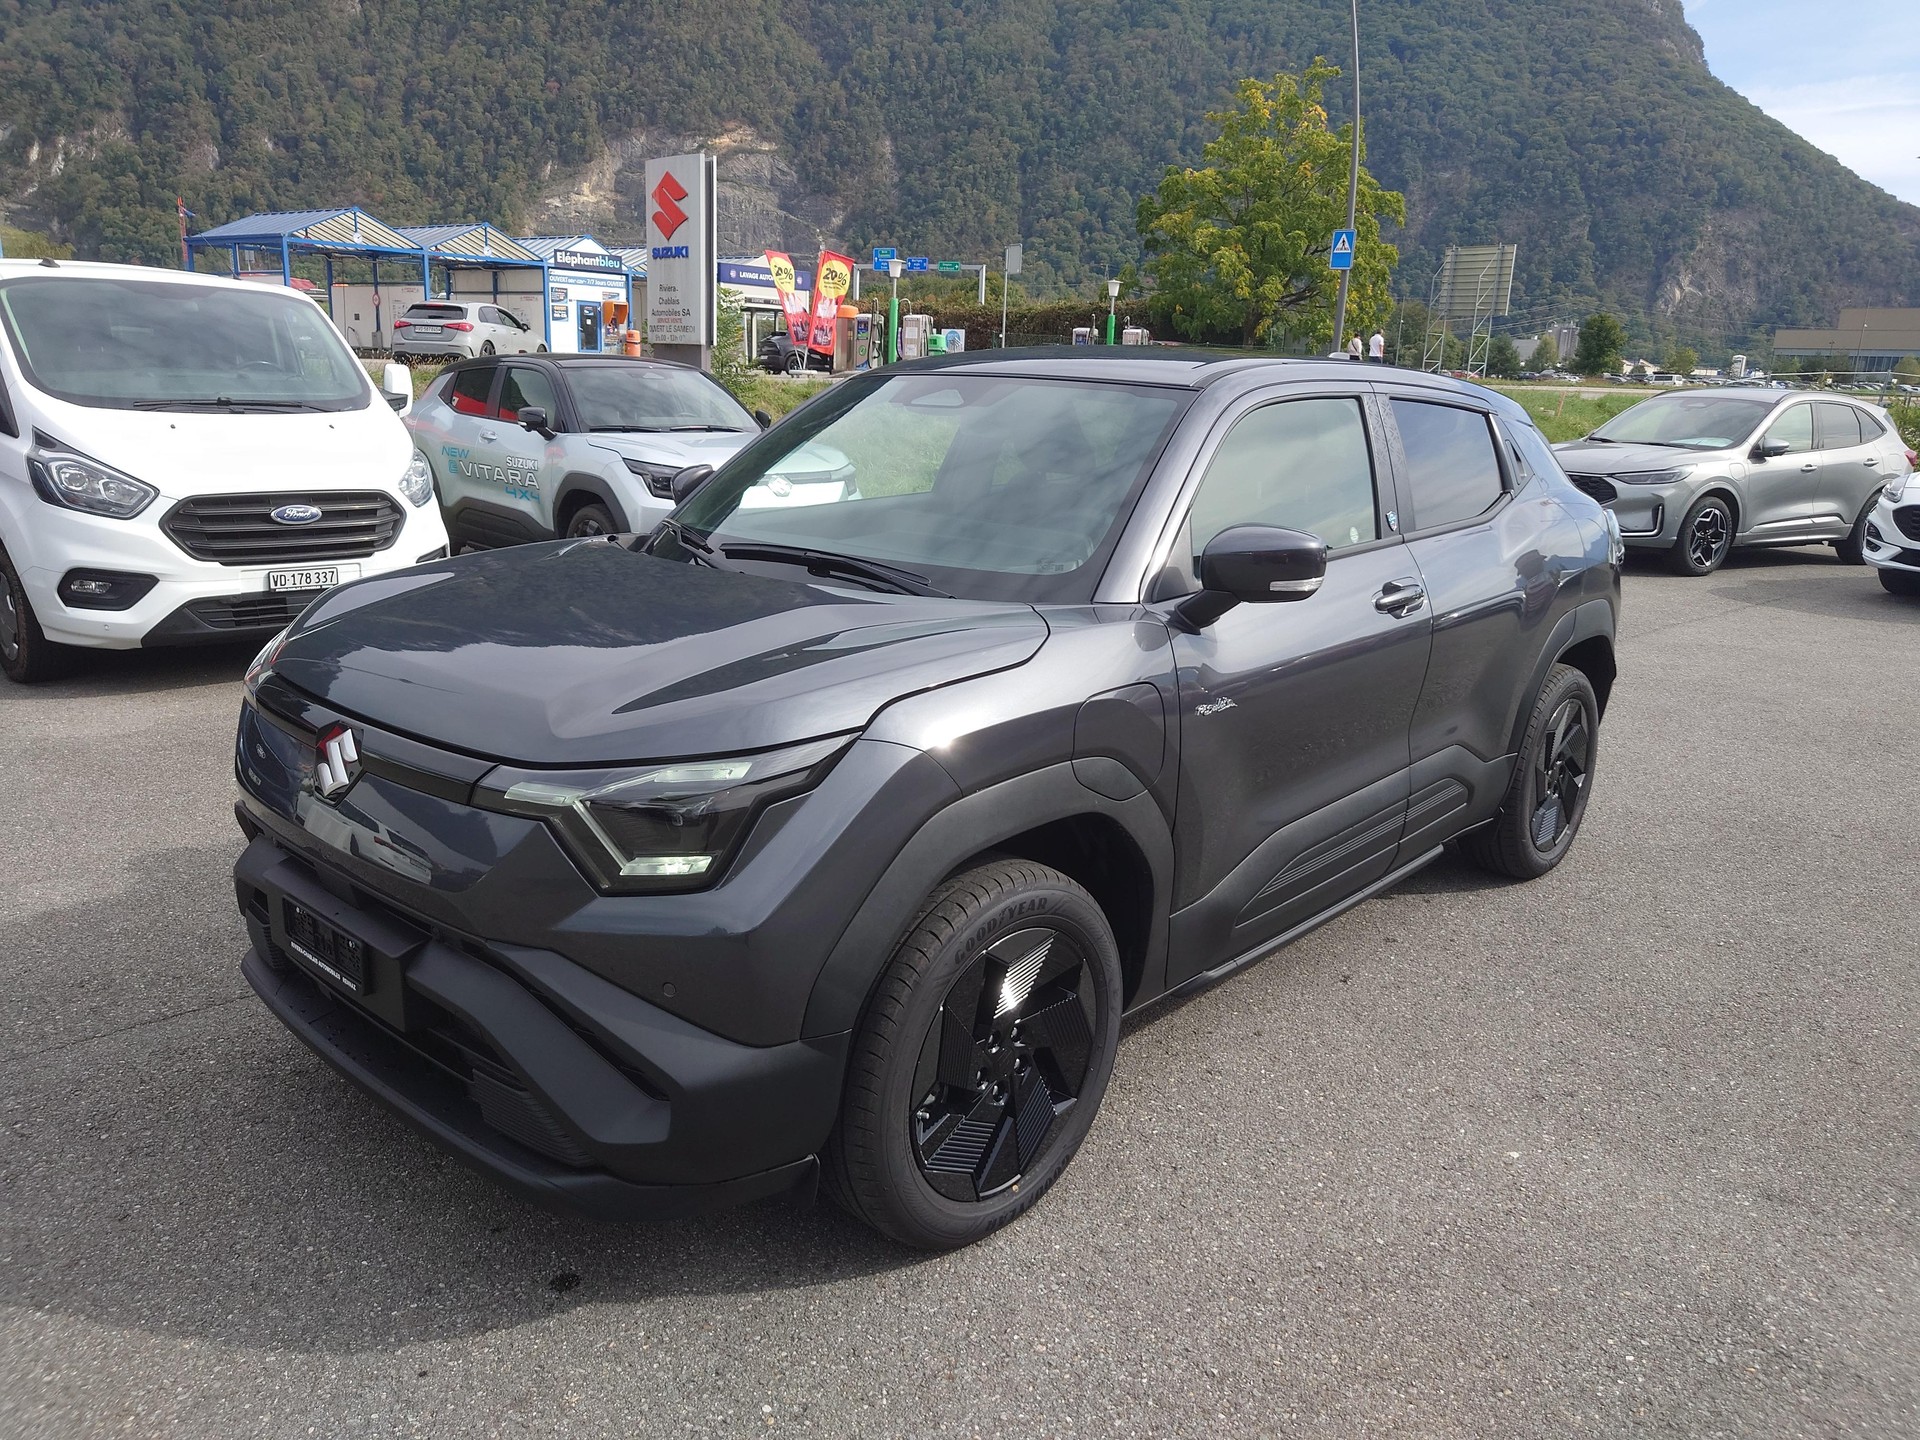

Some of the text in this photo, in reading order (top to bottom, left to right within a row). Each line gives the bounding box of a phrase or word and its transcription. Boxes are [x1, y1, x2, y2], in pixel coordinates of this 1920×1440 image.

[652, 246, 689, 259] SUZUKI
[740, 271, 758, 279] LAVAGE
[759, 273, 774, 281] AUTO
[823, 268, 847, 285] 20%
[651, 308, 691, 317] Automobiles SA
[666, 325, 673, 333] LE
[674, 325, 695, 333] SAMEDI
[442, 446, 470, 459] NEW
[506, 455, 539, 471] SUZUKI
[459, 460, 540, 490] VITARA
[283, 507, 313, 519] Ford
[954, 896, 1049, 966] GOODYEAR
